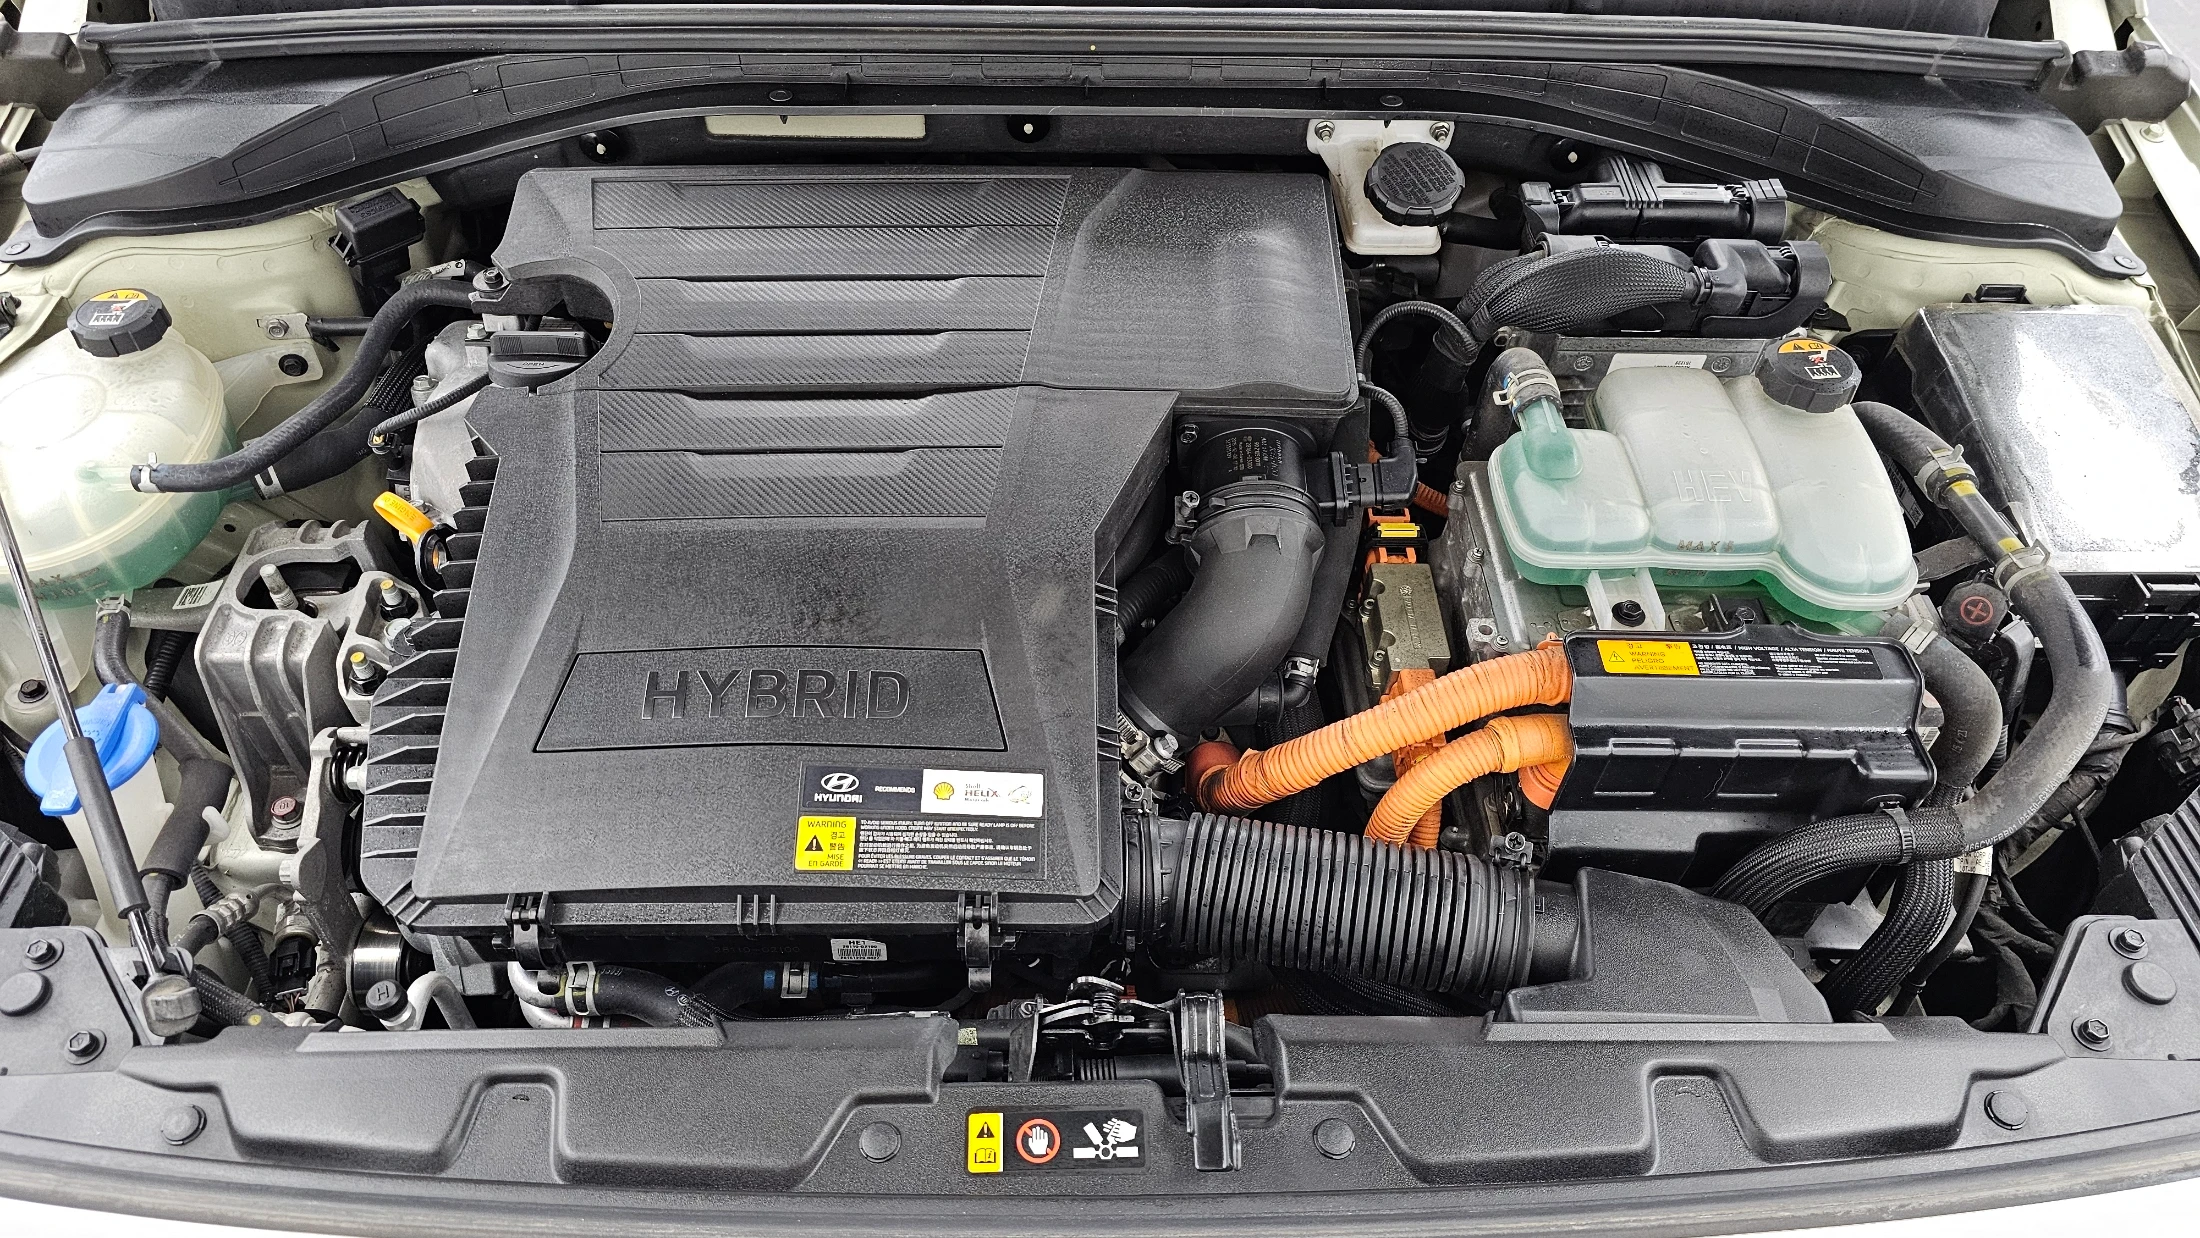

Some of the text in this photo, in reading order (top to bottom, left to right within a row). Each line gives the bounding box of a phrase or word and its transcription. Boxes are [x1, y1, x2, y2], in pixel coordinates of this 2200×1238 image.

[1672, 470, 1752, 502] HEV
[1677, 540, 1720, 552] MAX
[642, 669, 910, 720] HYBRID
[814, 792, 862, 803] HYUNDAI
[964, 788, 999, 798] HELIX
